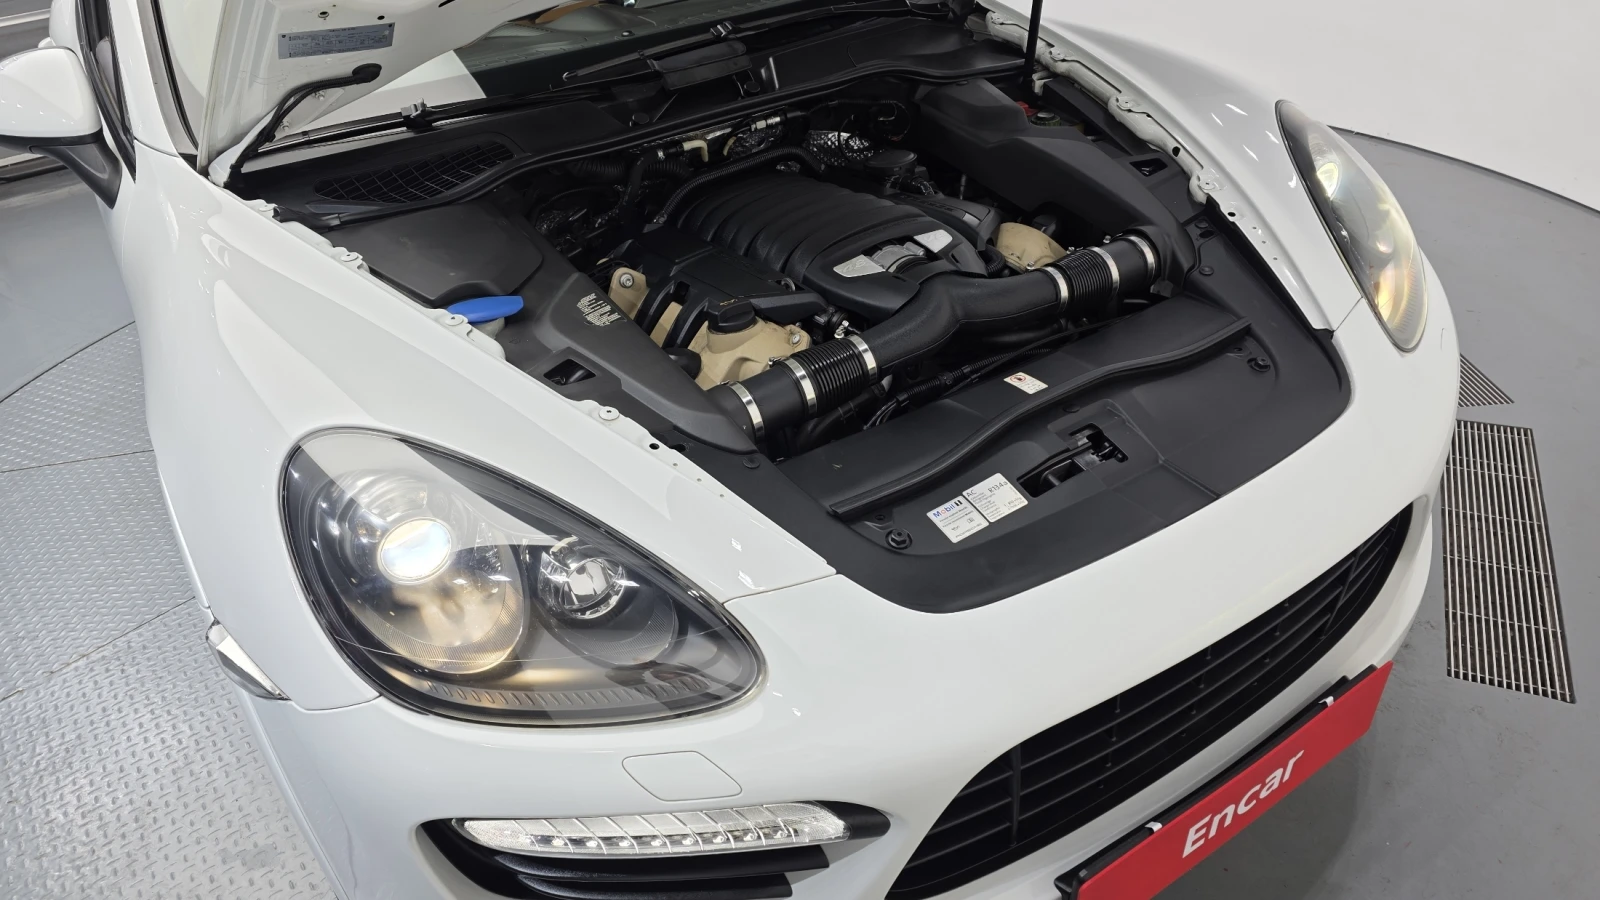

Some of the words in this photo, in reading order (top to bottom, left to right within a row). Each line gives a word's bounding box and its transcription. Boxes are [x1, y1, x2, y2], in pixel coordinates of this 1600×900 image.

[966, 489, 977, 498] AC
[987, 481, 1009, 494] R134a
[933, 503, 956, 518] Mobil
[1182, 750, 1305, 858] Encar
